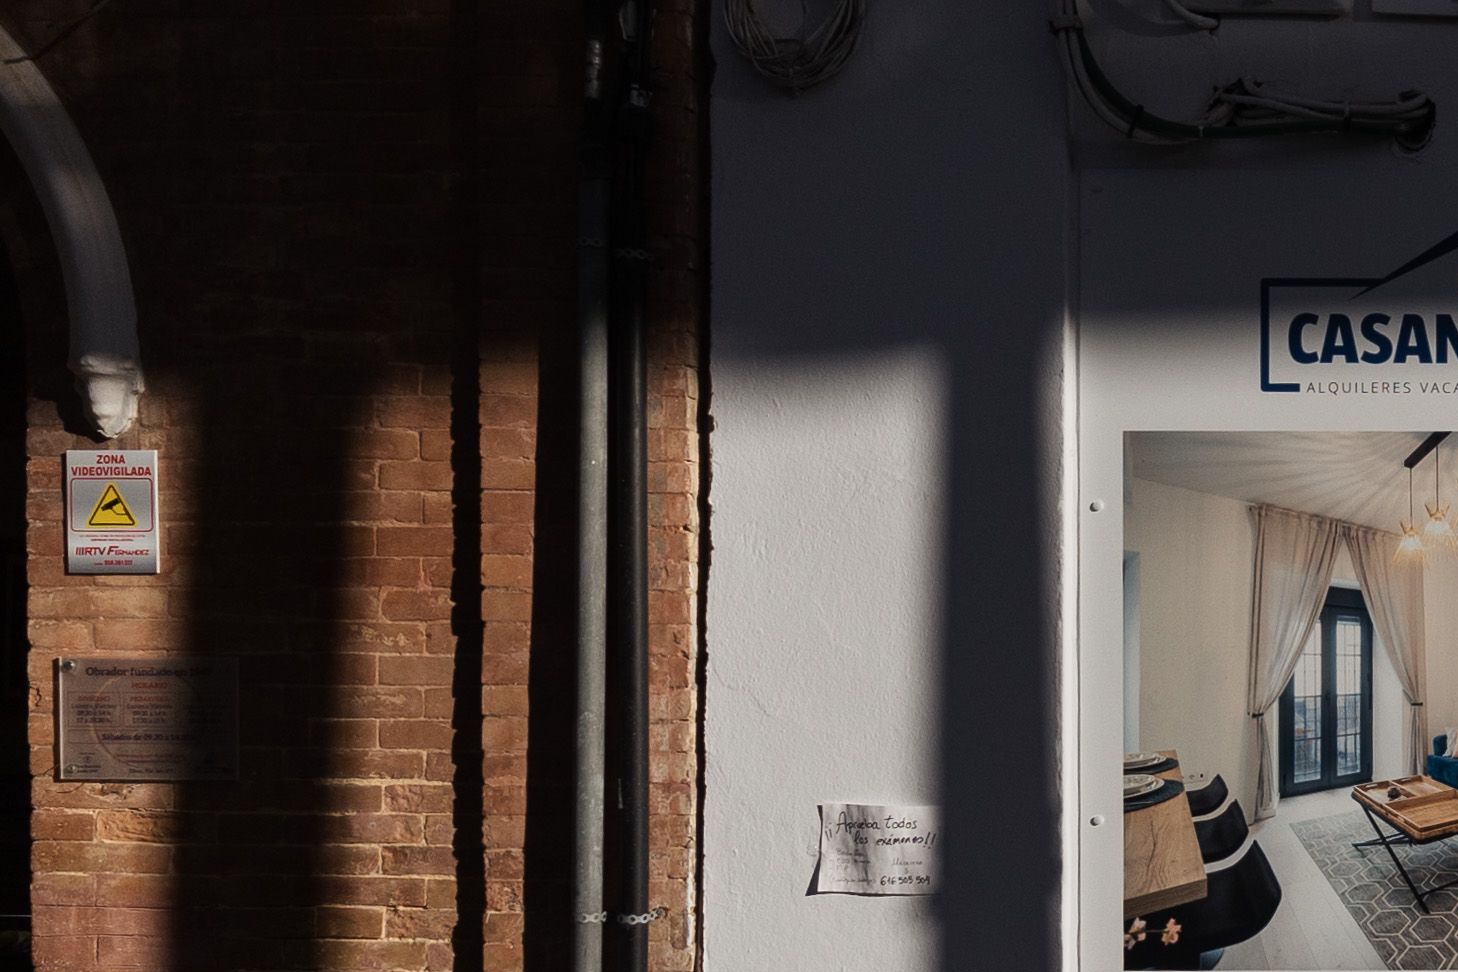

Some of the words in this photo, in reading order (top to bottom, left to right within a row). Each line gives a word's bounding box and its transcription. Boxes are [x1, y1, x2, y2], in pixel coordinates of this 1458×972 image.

[1306, 381, 1411, 396] ALQUILERES
[96, 455, 126, 464] ZONA
[71, 466, 152, 476] VIDEOVIGILADA
[884, 816, 918, 829] todos
